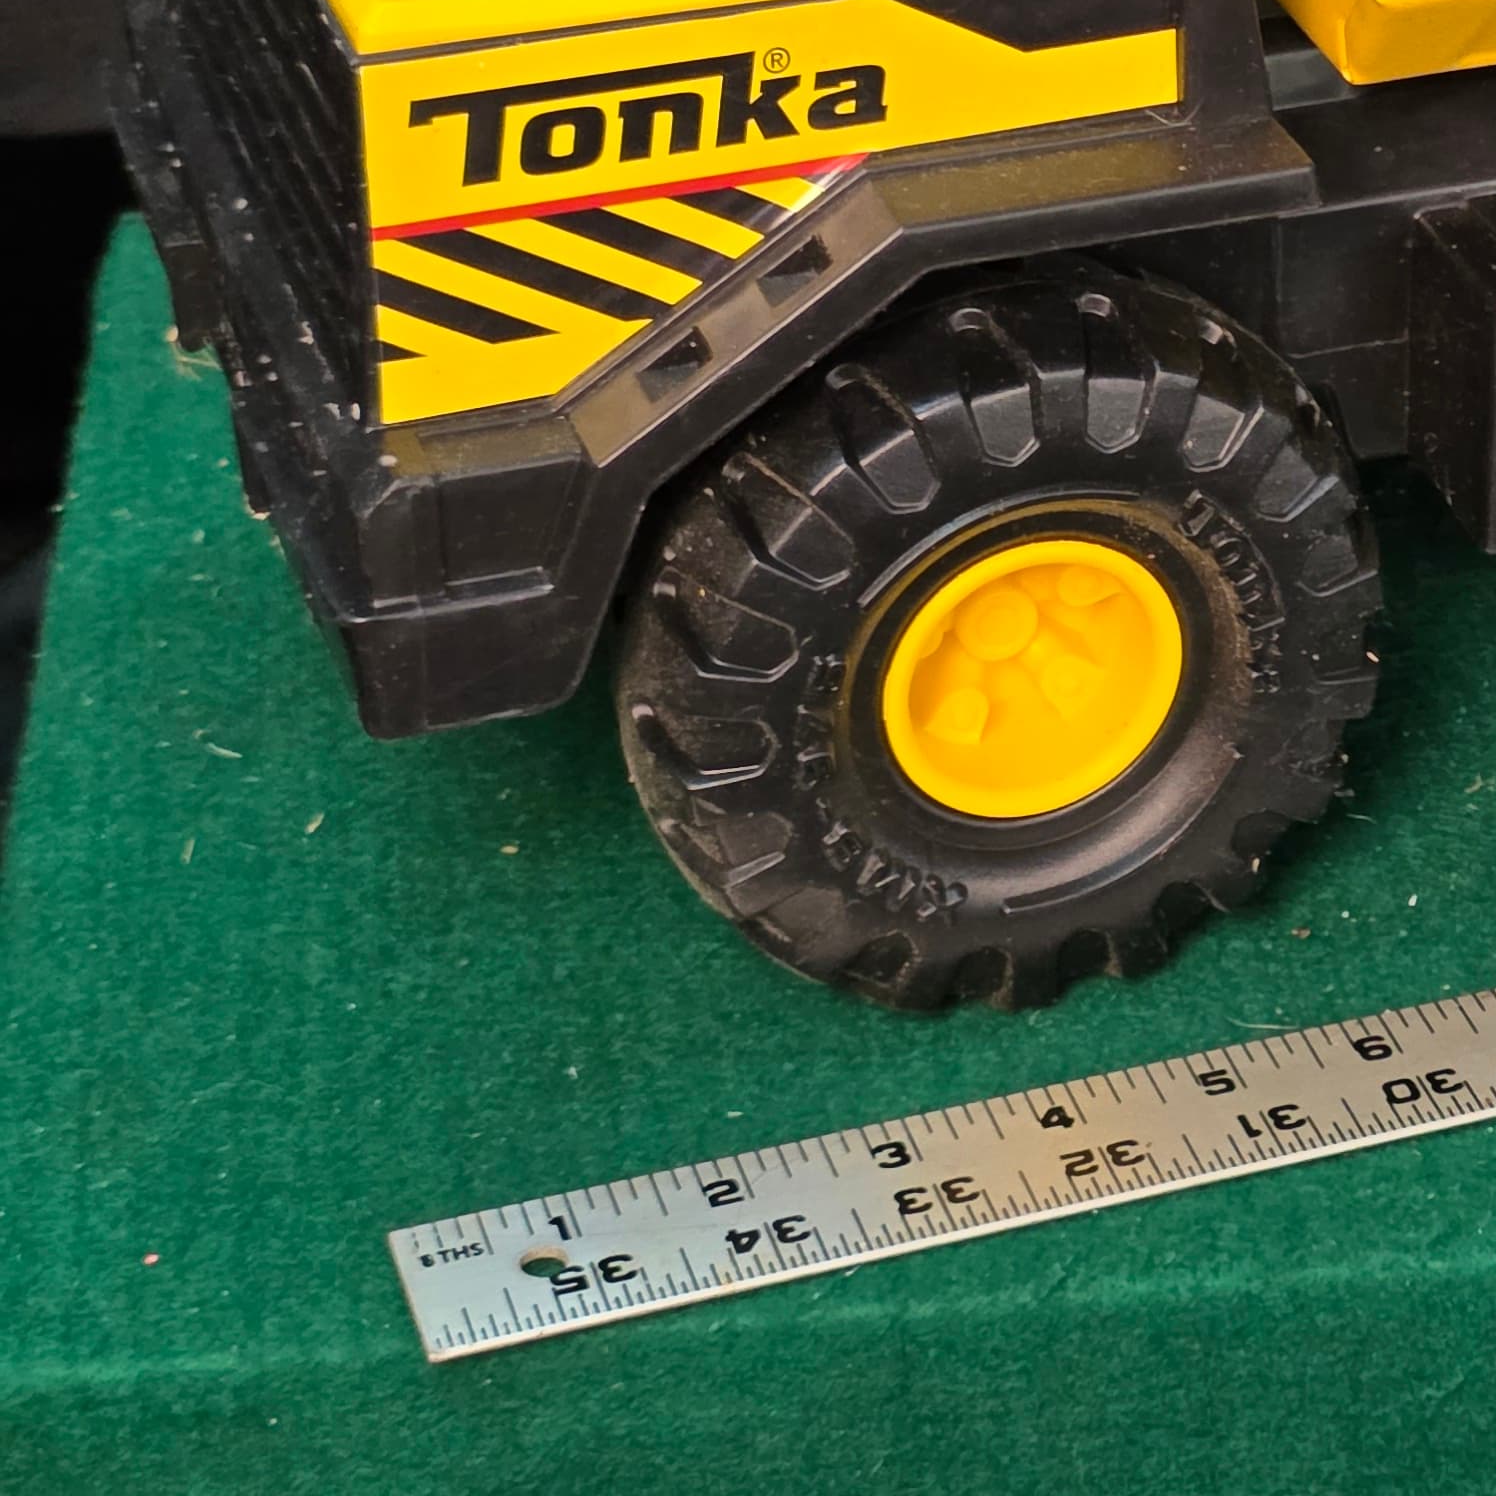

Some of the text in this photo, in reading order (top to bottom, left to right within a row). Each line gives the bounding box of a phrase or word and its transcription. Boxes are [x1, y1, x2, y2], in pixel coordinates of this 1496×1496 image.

[409, 51, 887, 186] Tonka
[1382, 1068, 1465, 1105] 30
[549, 1216, 572, 1240] 1
[704, 1179, 744, 1207] 2
[871, 1141, 911, 1168] 3
[1039, 1107, 1074, 1128] 4
[1198, 1070, 1236, 1095] 5
[1354, 1036, 1392, 1061] 6
[1236, 1104, 1307, 1139] 31
[1060, 1139, 1146, 1178] 32
[894, 1177, 981, 1215] 33
[725, 1215, 811, 1254] 34
[550, 1254, 641, 1296] 35
